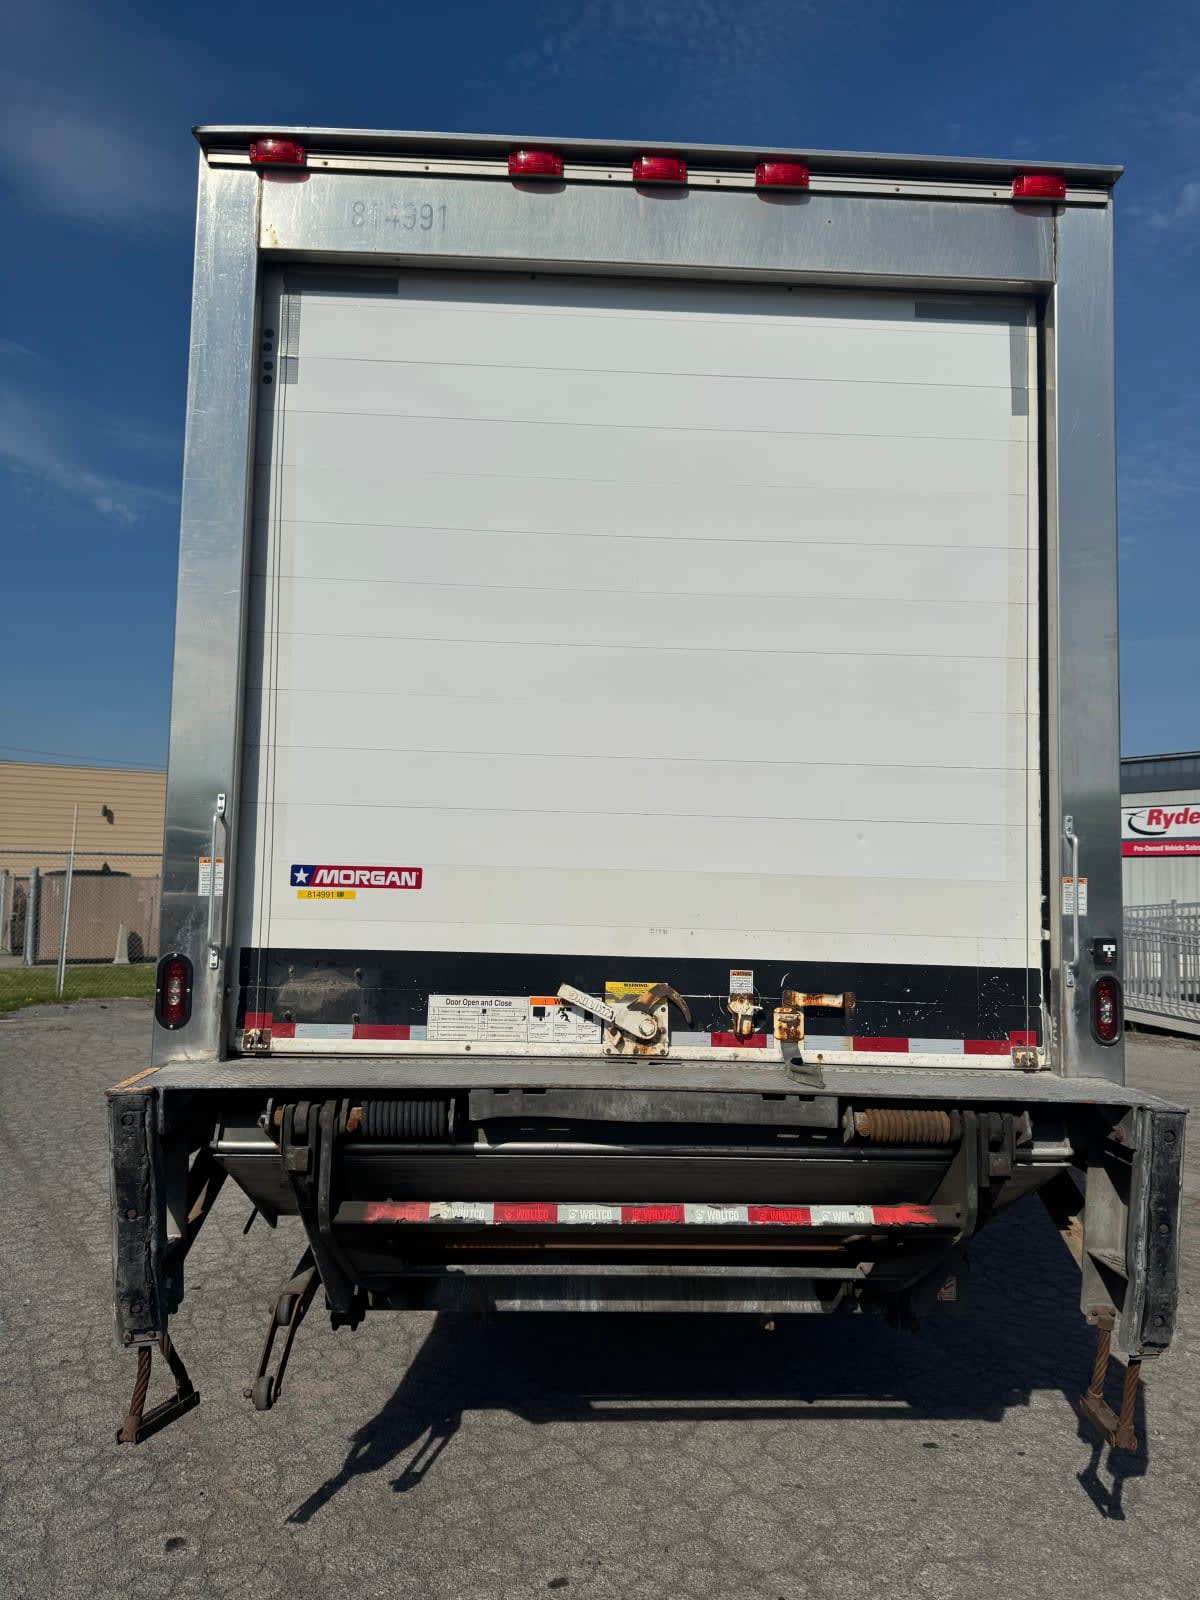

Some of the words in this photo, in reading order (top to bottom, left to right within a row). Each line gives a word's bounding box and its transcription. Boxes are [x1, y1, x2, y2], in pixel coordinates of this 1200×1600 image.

[315, 869, 417, 887] MORGAN
[307, 890, 335, 898] 814991
[445, 998, 460, 1006] Door
[462, 998, 479, 1007] Open
[480, 999, 493, 1007] and
[494, 999, 513, 1007] Close
